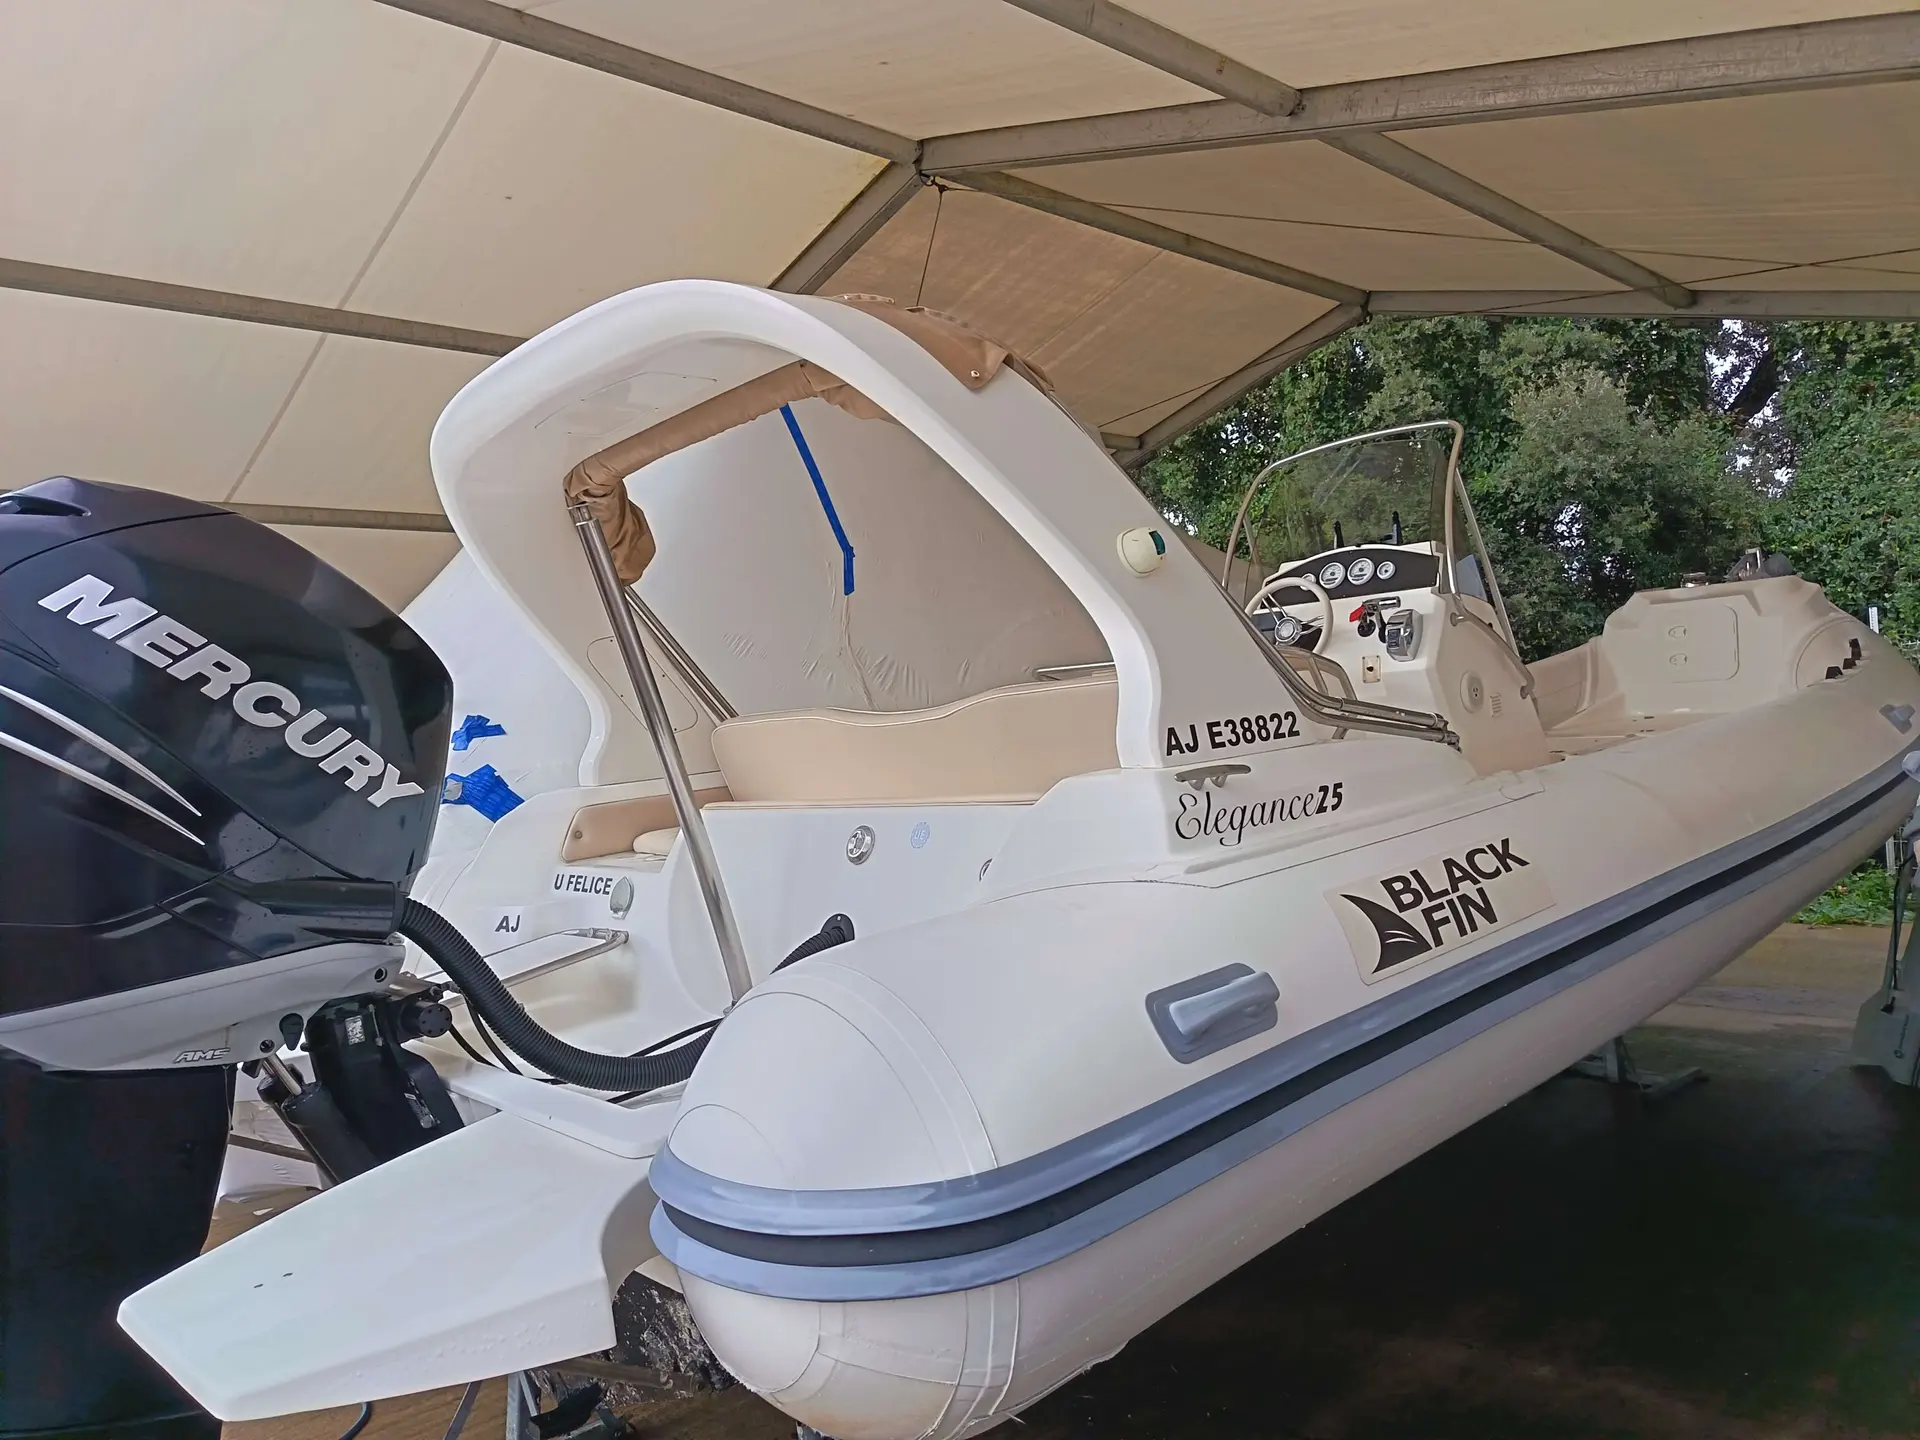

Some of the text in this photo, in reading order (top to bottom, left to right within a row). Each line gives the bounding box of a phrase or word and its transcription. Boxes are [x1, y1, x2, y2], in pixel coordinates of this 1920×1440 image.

[38, 574, 424, 808] MERCURY
[1166, 711, 1300, 756] AJ E38822
[554, 873, 613, 895] U FELICE
[1380, 837, 1530, 914] BLACK
[495, 914, 521, 933] AJ
[1421, 886, 1498, 948] FIN
[173, 1047, 231, 1064] AMS
